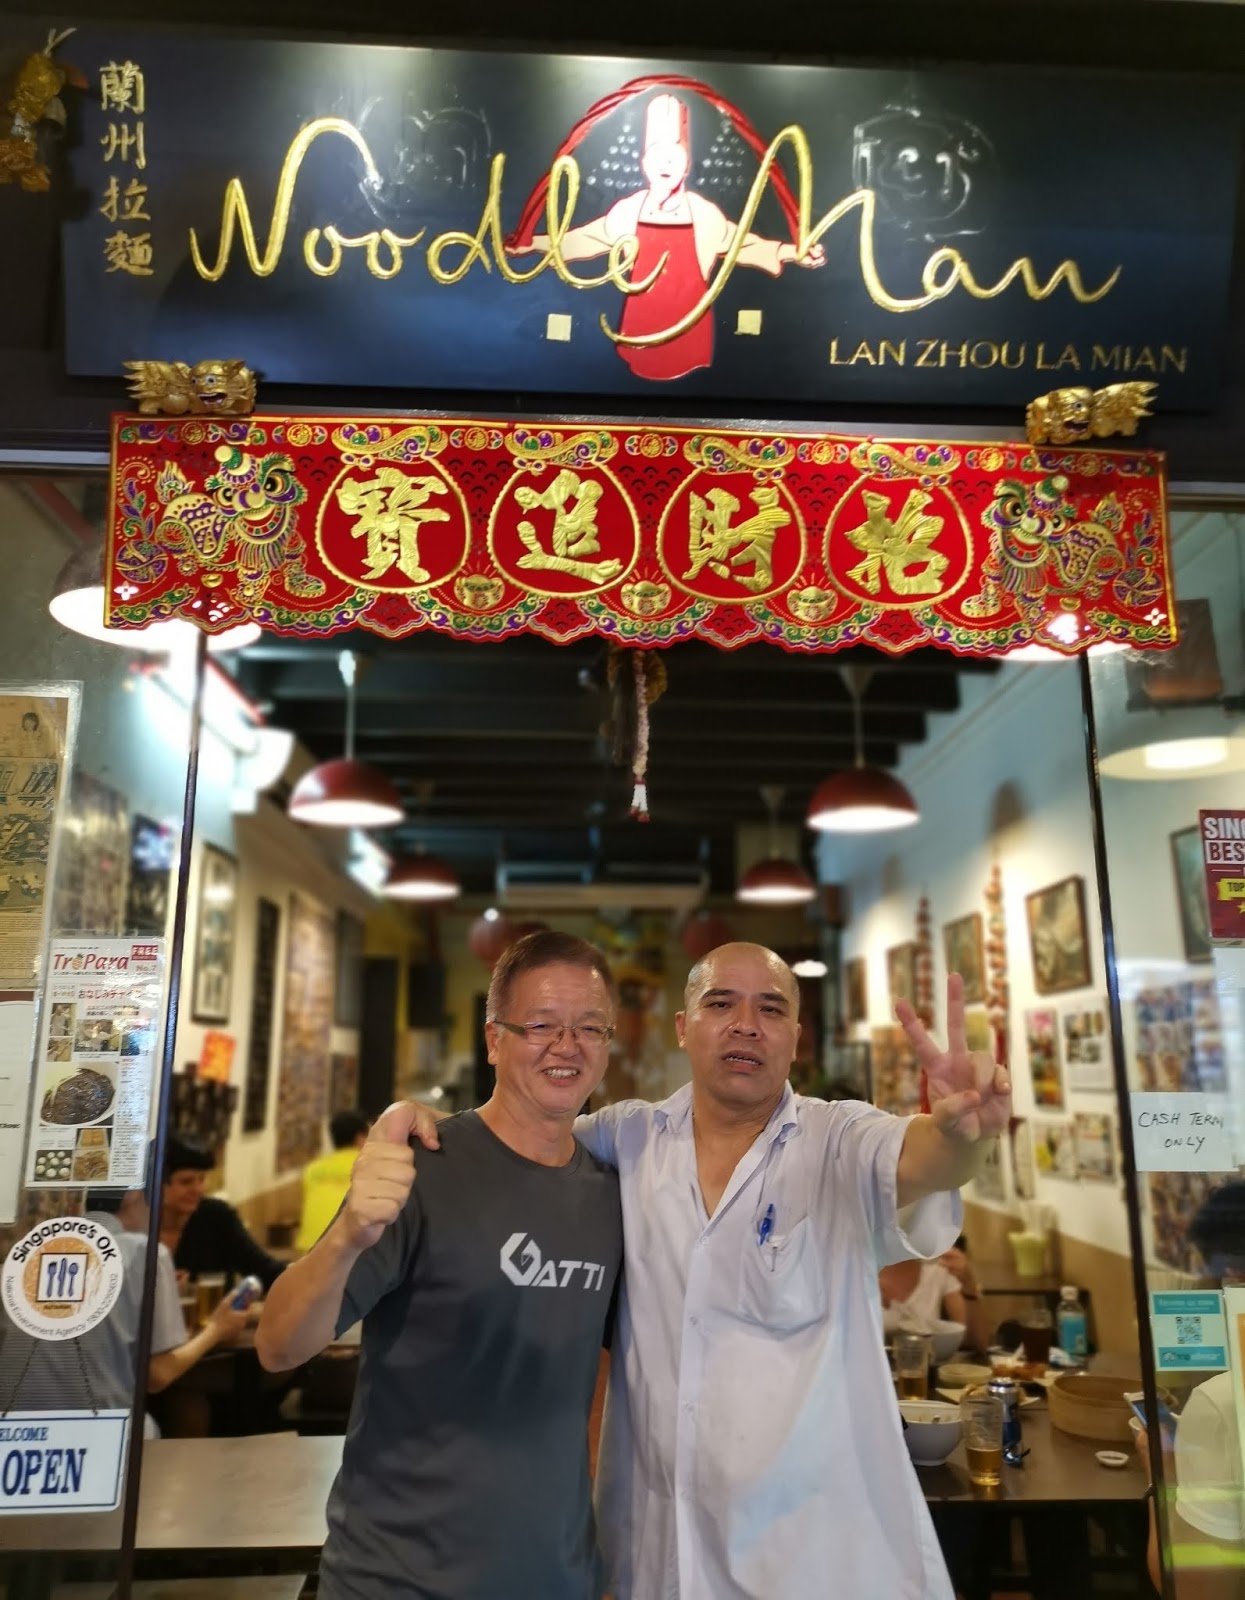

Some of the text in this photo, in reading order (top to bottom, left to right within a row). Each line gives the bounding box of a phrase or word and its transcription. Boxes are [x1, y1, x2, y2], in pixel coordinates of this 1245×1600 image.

[99, 60, 154, 276] 蘭州拉麵
[188, 116, 1121, 347] Noodle Man
[830, 337, 1189, 374] LAN ZHOU LA MIAN
[132, 946, 158, 956] FREE
[1138, 1112, 1181, 1128] CASH
[1164, 1136, 1205, 1154] ONLY
[13, 1221, 117, 1263] Singapore's OK
[500, 1232, 606, 1291] GATTI
[56, 1324, 86, 1337] Agency
[3, 1449, 87, 1496] OPEN
